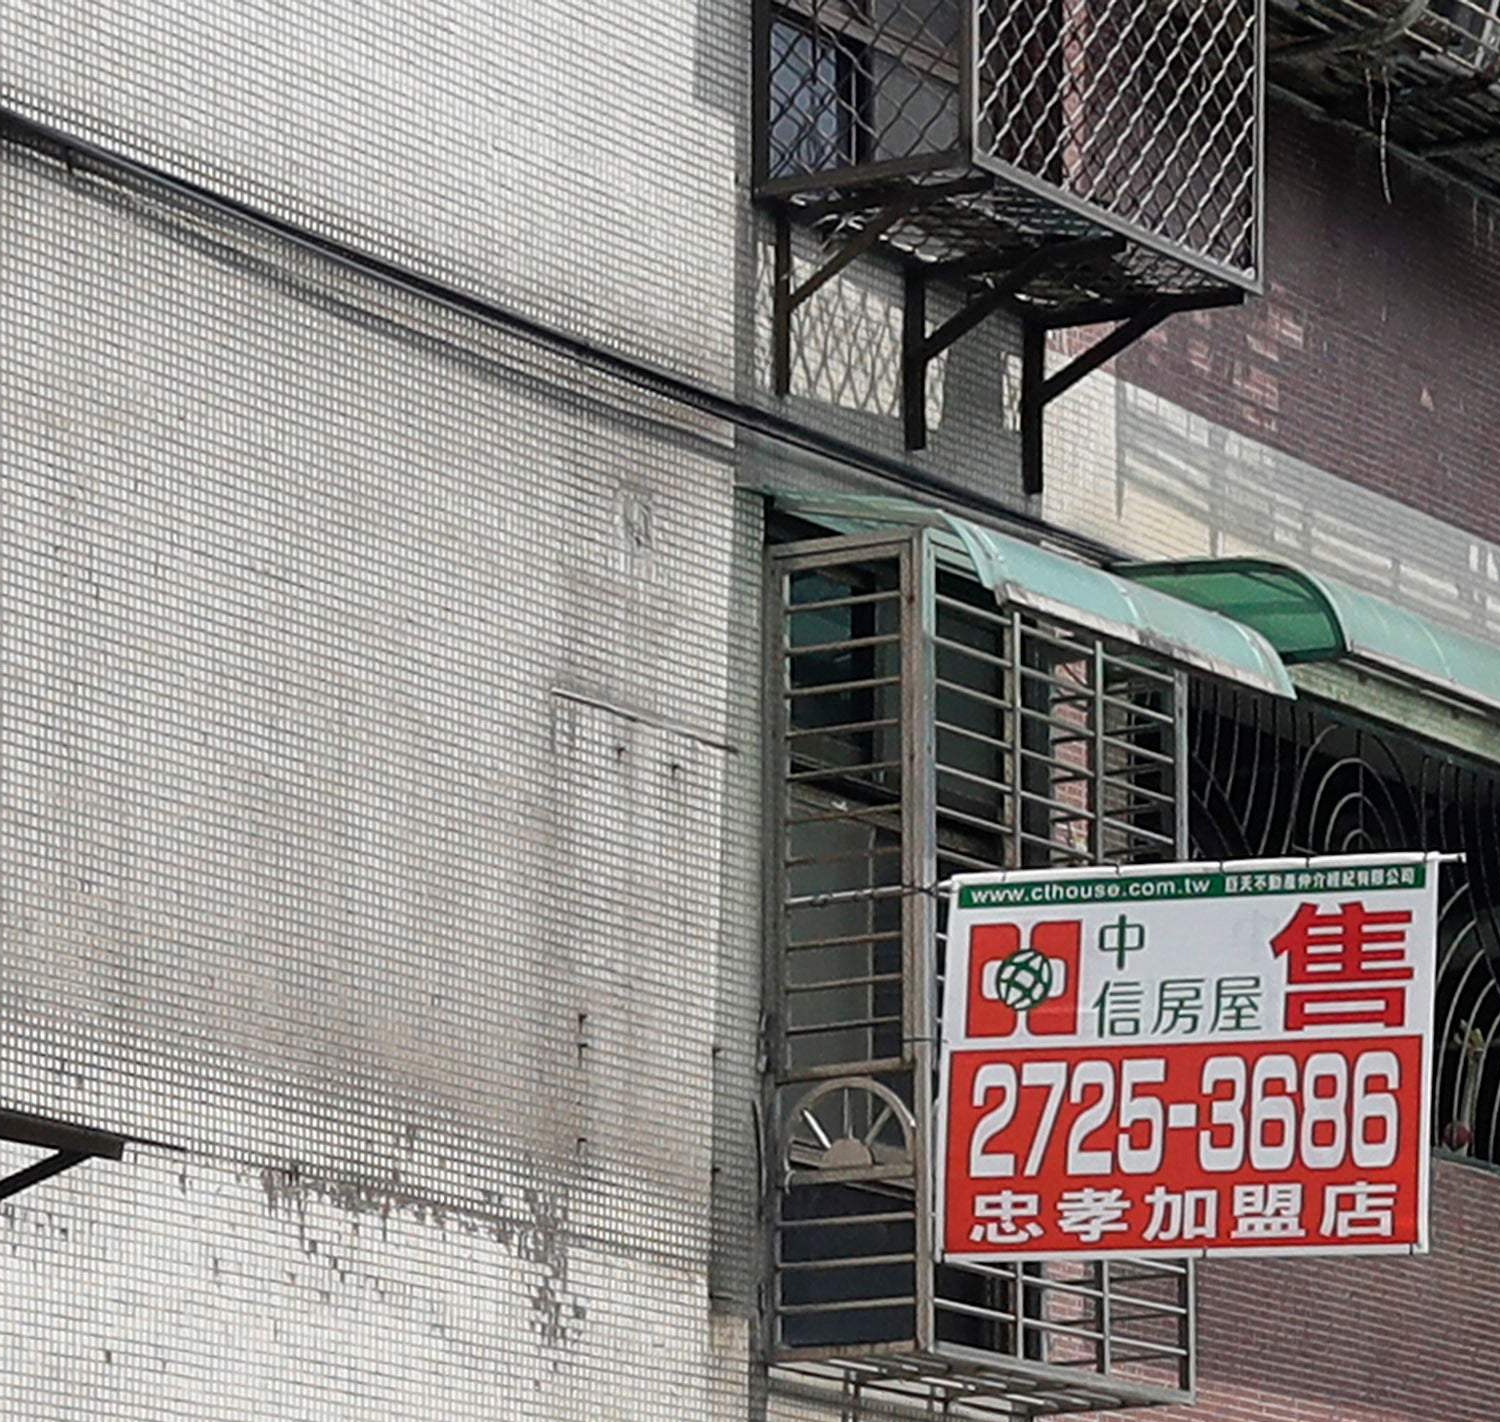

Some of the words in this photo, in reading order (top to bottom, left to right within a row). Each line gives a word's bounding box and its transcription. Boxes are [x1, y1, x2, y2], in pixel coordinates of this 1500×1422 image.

[970, 877, 1211, 905] www.cthouse.com.tw
[1269, 900, 1416, 1034] 售
[968, 1049, 1400, 1178] 2725-3686
[968, 1180, 1399, 1244] 忠孝加盟店
